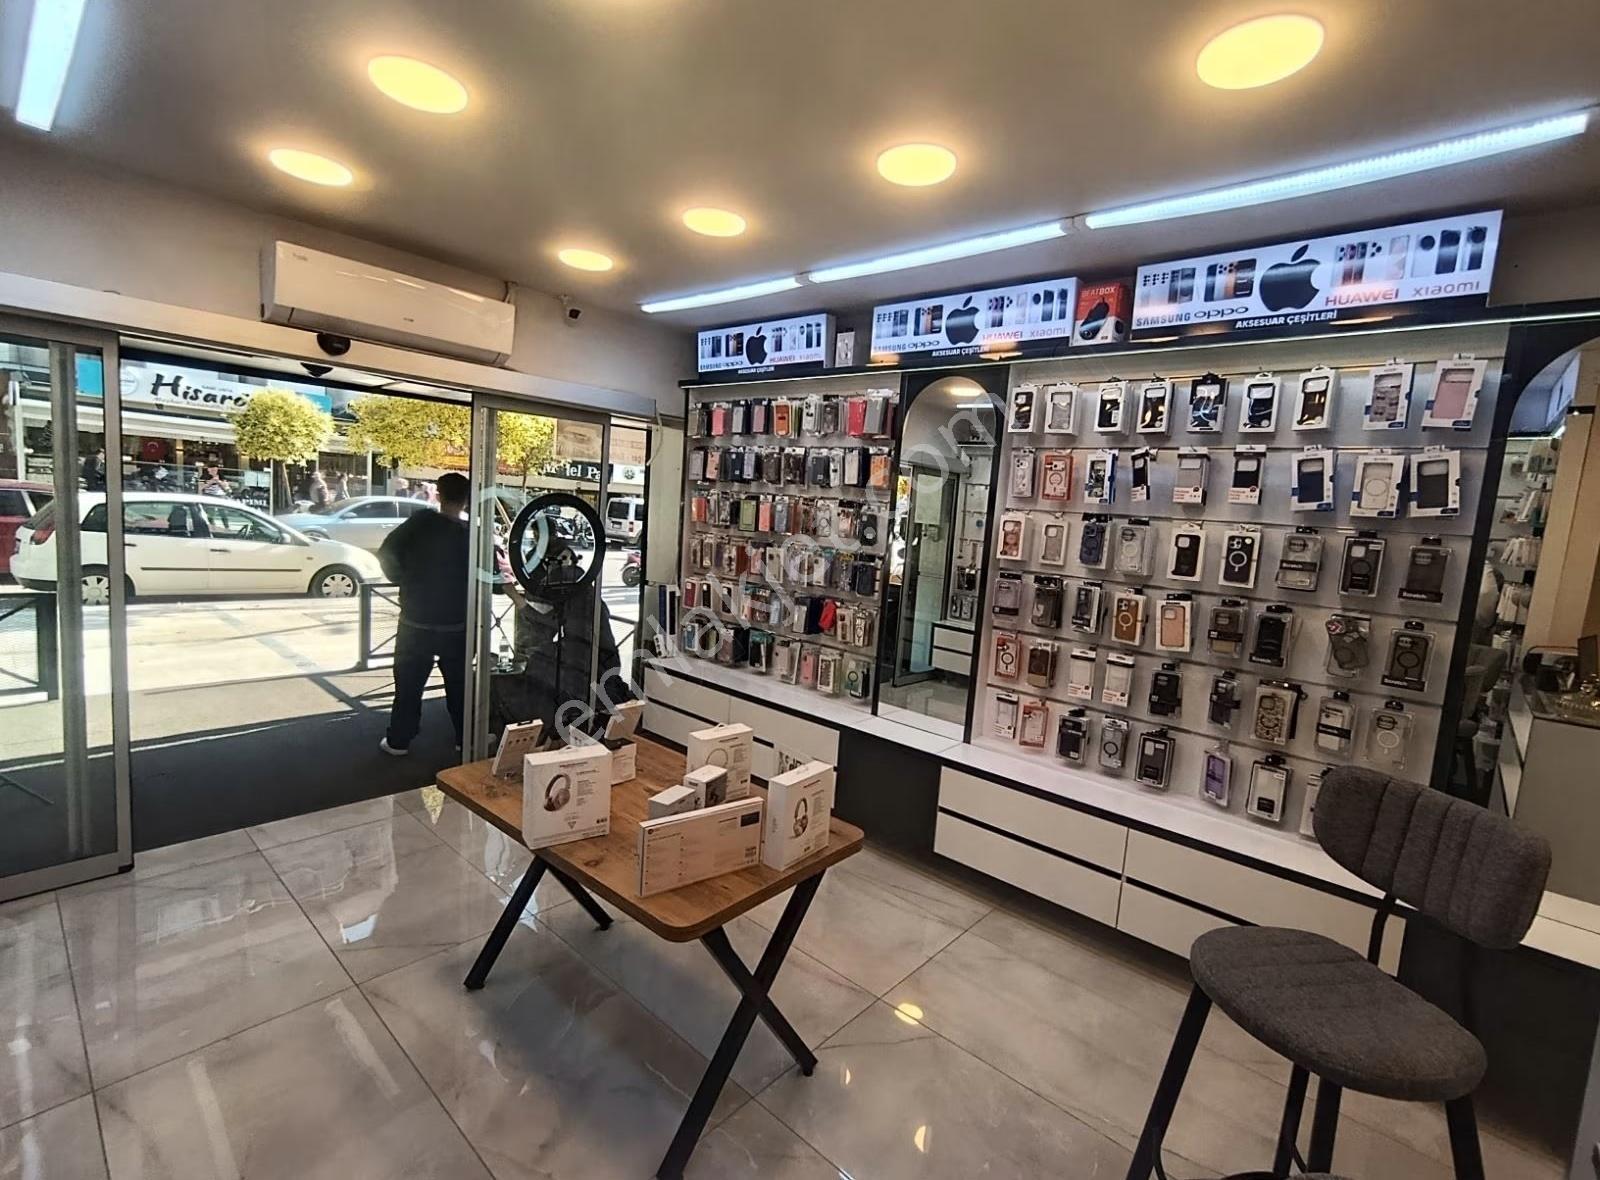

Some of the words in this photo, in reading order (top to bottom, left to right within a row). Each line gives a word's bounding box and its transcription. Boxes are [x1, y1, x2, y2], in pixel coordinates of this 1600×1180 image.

[1325, 288, 1399, 306] HUAWEI
[1136, 312, 1191, 327] SAMSUNG
[1194, 306, 1249, 319] oppo
[1235, 316, 1285, 328] AKSESUAR
[1286, 309, 1337, 325] ÇEŞİTLERİ
